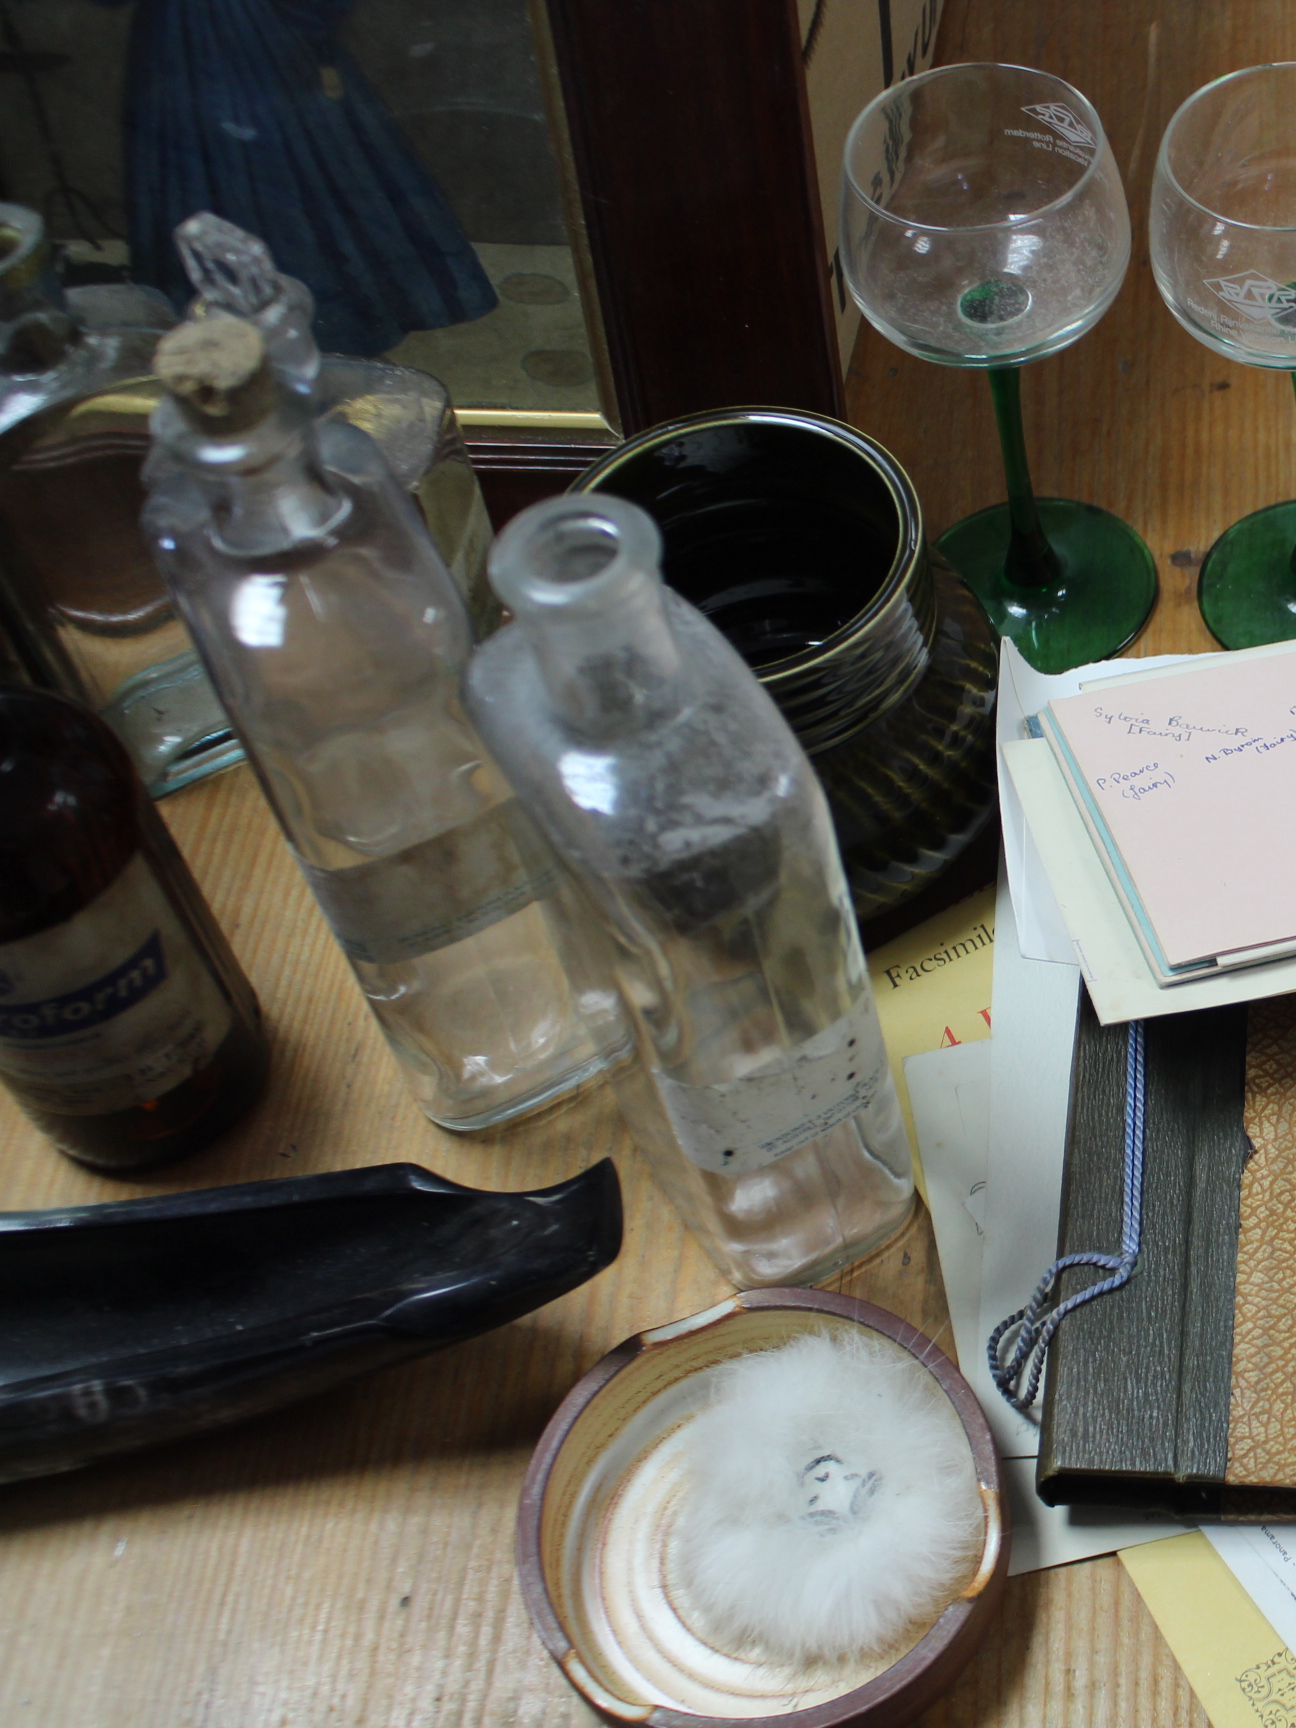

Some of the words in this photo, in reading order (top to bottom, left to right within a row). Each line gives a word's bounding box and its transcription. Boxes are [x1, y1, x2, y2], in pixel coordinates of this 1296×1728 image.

[1210, 319, 1238, 336] Rhine
[1110, 761, 1159, 785] Pearce
[1260, 1525, 1292, 1563] Panorama
